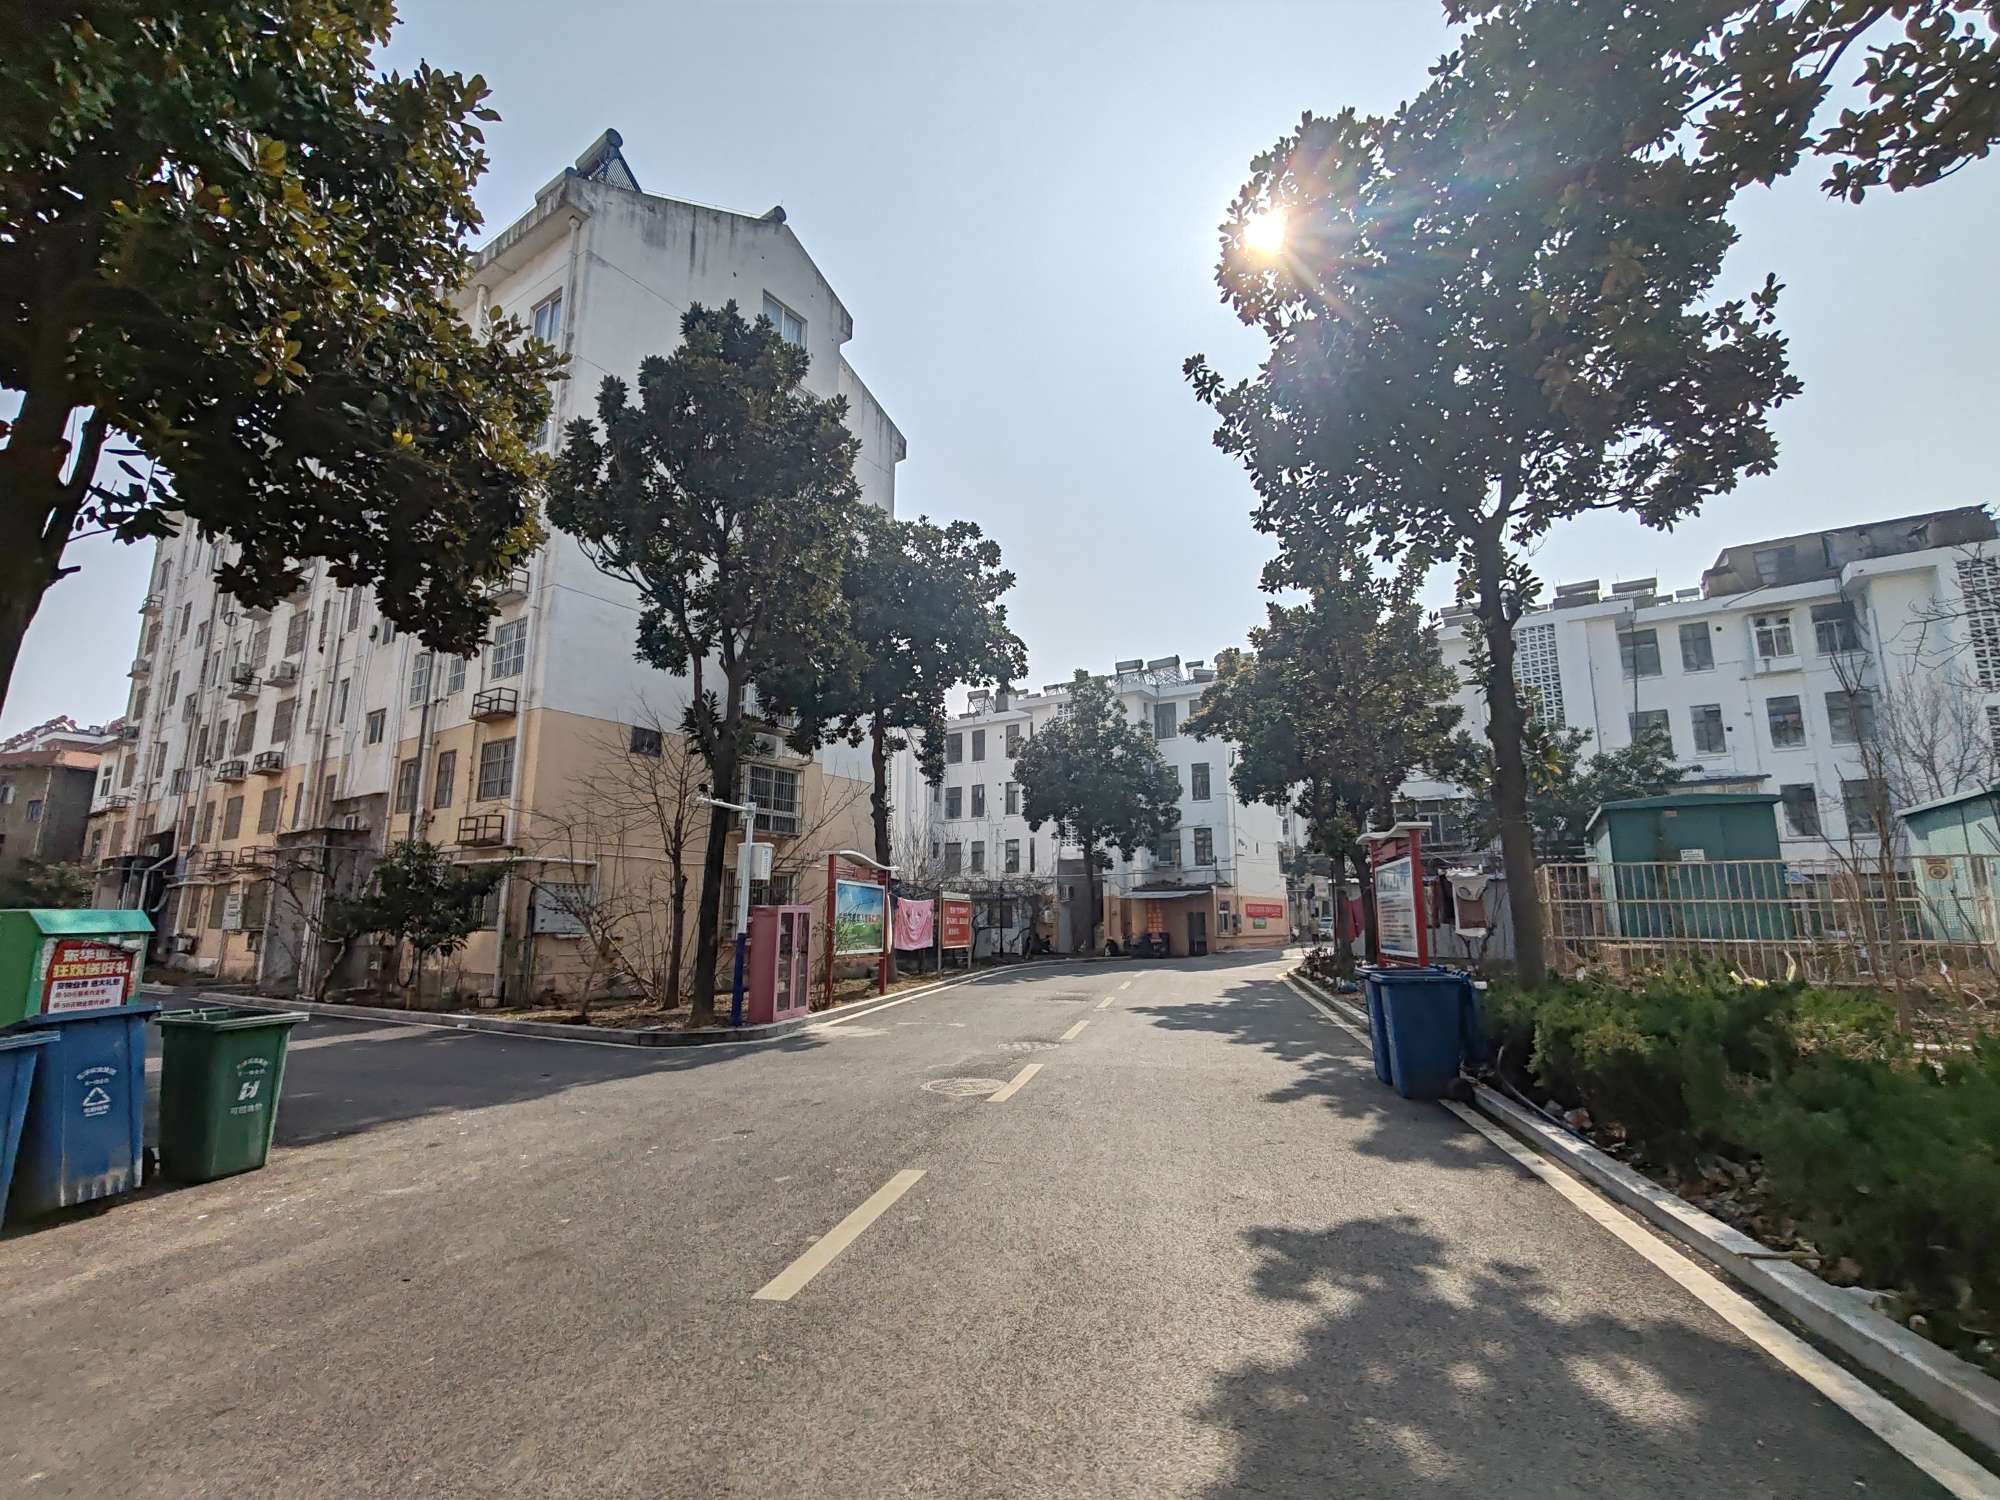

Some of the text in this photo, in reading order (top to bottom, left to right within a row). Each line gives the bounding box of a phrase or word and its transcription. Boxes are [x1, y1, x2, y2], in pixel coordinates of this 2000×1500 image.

[53, 961, 129, 977] 狂欢送好礼
